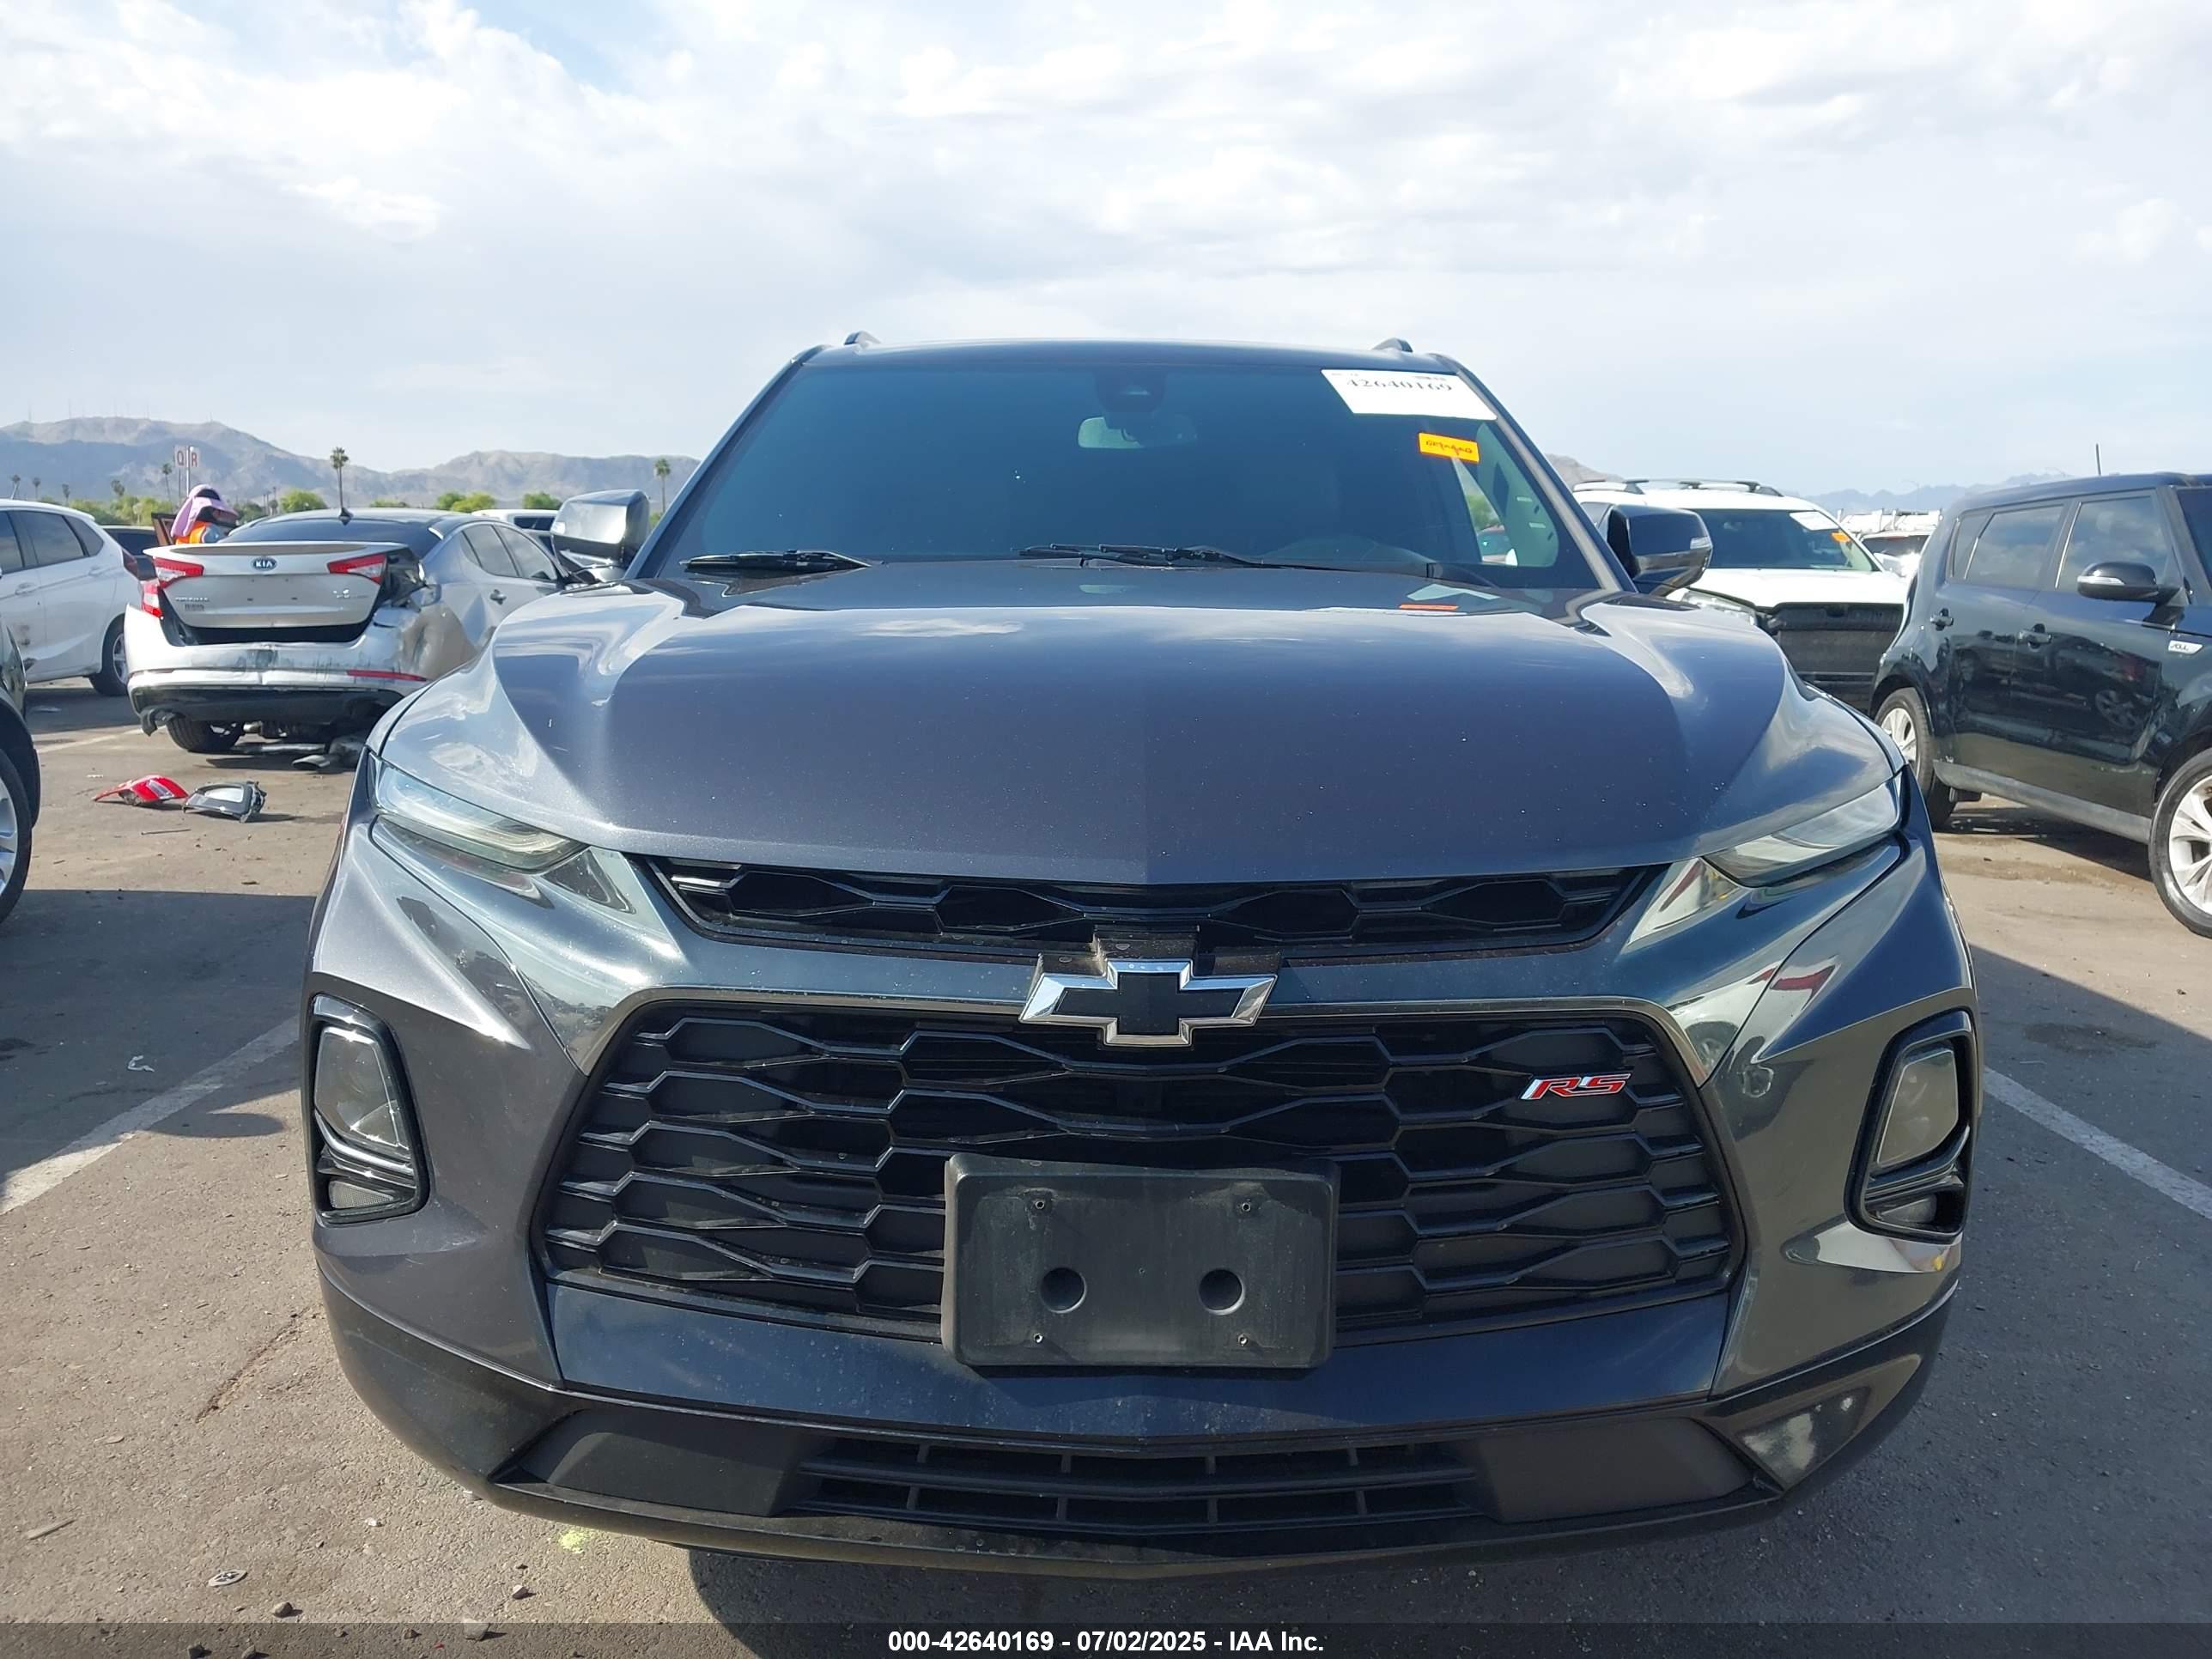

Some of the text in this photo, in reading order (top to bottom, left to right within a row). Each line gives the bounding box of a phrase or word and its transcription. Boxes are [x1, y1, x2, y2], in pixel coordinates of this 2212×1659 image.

[177, 450, 185, 466] Q
[191, 452, 198, 467] R
[1521, 1073, 1631, 1100] RS
